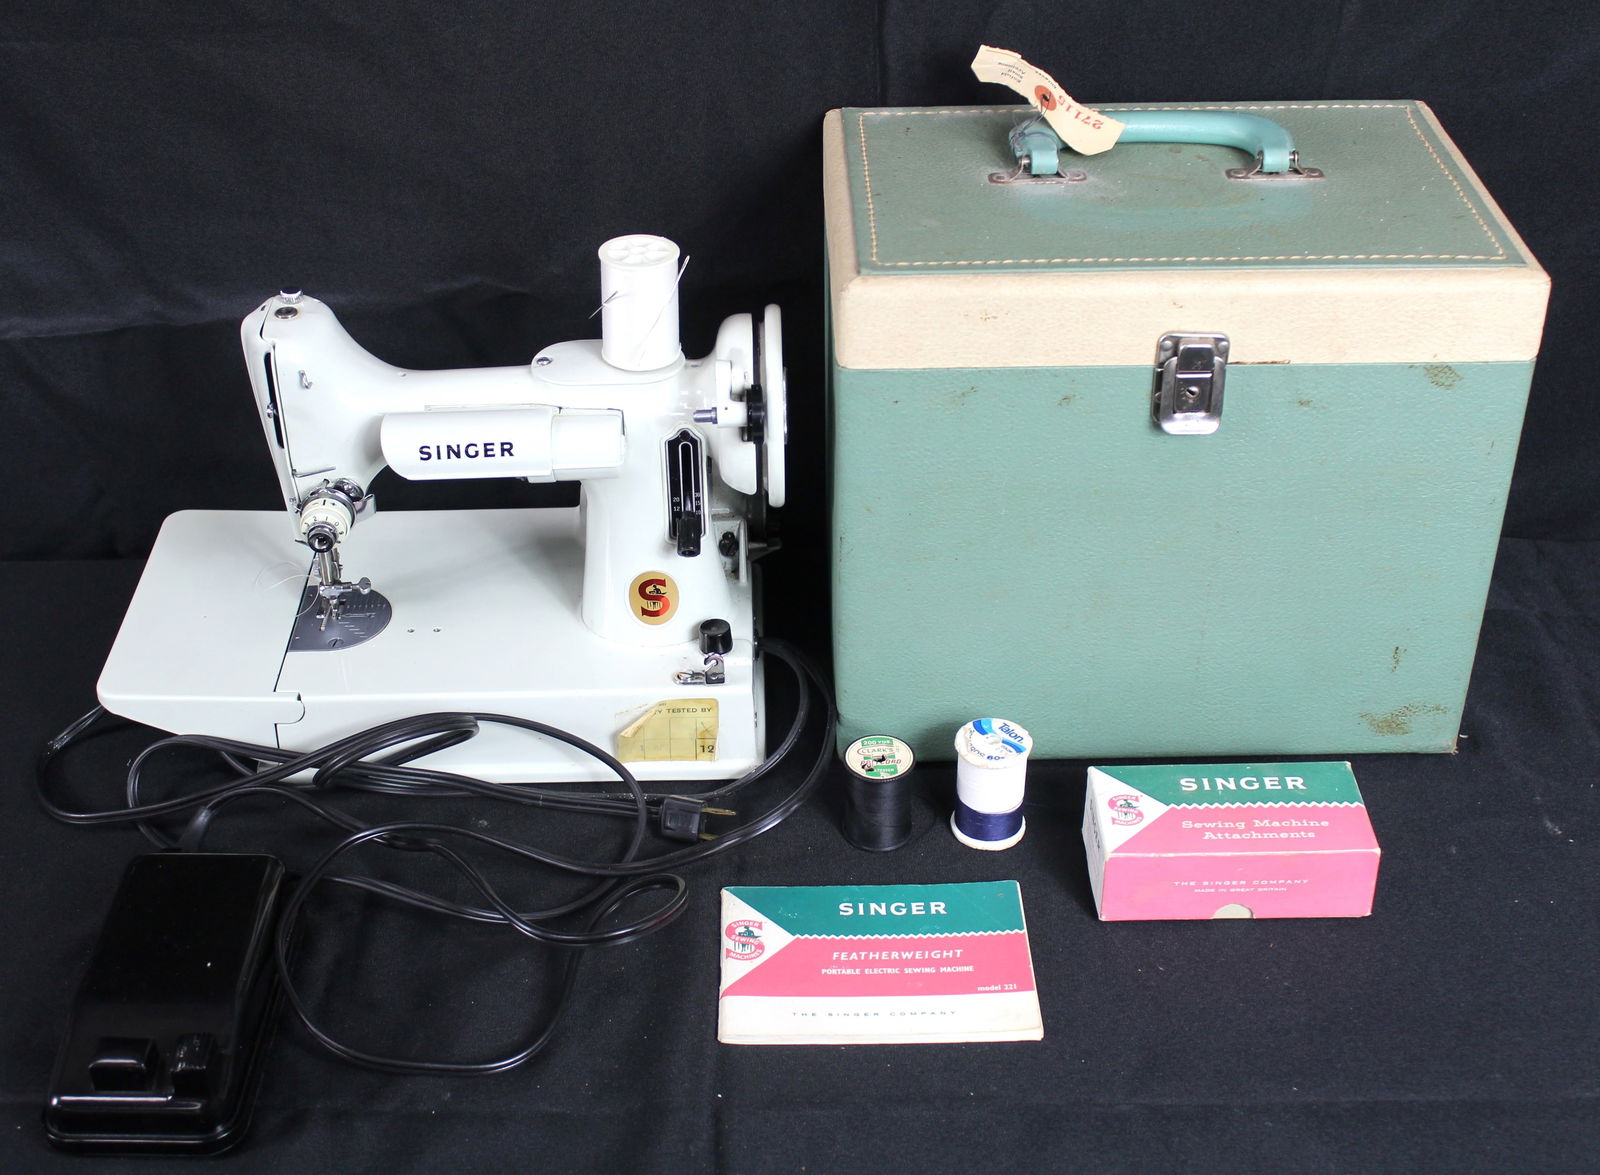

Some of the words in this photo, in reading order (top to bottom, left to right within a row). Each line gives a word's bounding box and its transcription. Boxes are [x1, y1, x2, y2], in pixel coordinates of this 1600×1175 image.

[418, 441, 515, 461] SINGER
[998, 722, 1025, 743] Talon
[700, 744, 715, 754] 12
[1179, 776, 1308, 792] SINGER
[1181, 820, 1246, 830] Sewing
[1253, 818, 1330, 828] Machine
[1202, 831, 1316, 841] Attachments
[838, 900, 948, 916] SINGER
[832, 949, 964, 961] FEATHERWEIGHT
[821, 967, 861, 975] PORTABLE
[865, 966, 901, 975] ELECTRIC
[904, 966, 936, 974] SEWING
[940, 965, 975, 973] MACHINE
[977, 984, 1002, 992] model
